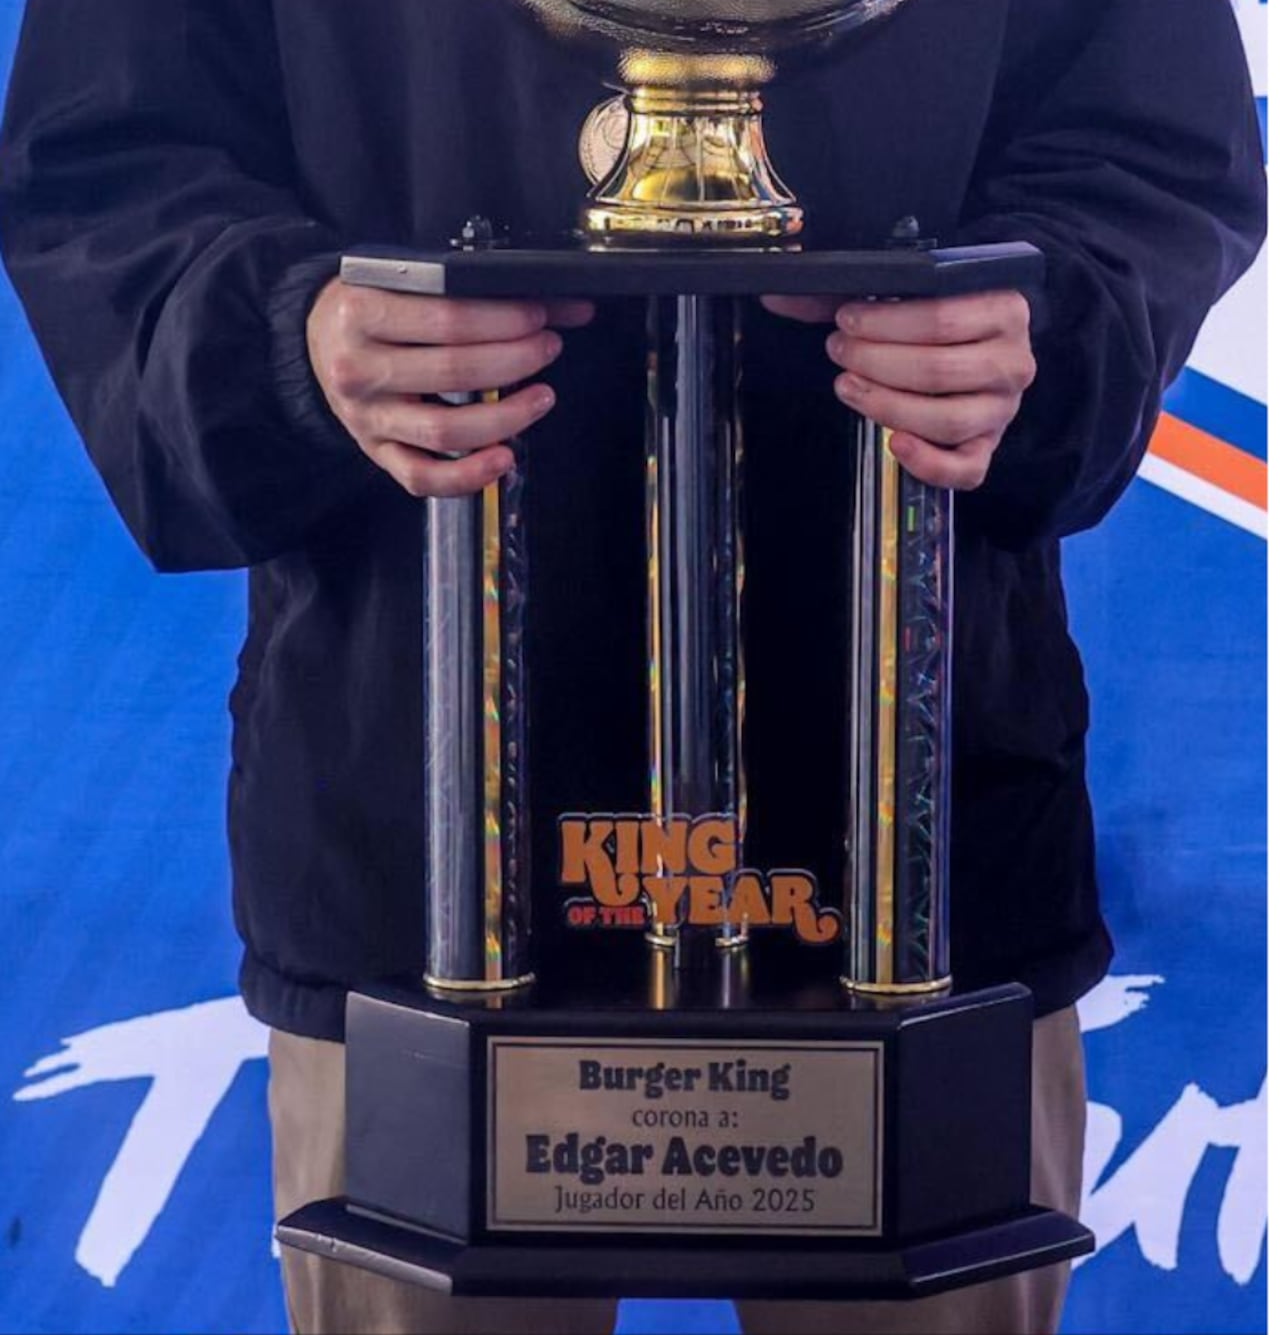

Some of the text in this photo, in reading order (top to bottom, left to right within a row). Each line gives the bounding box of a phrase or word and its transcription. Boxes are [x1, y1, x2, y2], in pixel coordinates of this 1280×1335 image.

[561, 820, 736, 906] KING
[569, 875, 839, 942] OF THE YEAR
[578, 1058, 792, 1100] Burger King
[632, 1109, 739, 1129] corona a:
[525, 1133, 844, 1185] Edgar Acevedo
[554, 1185, 816, 1214] Jugador del Año 2025
